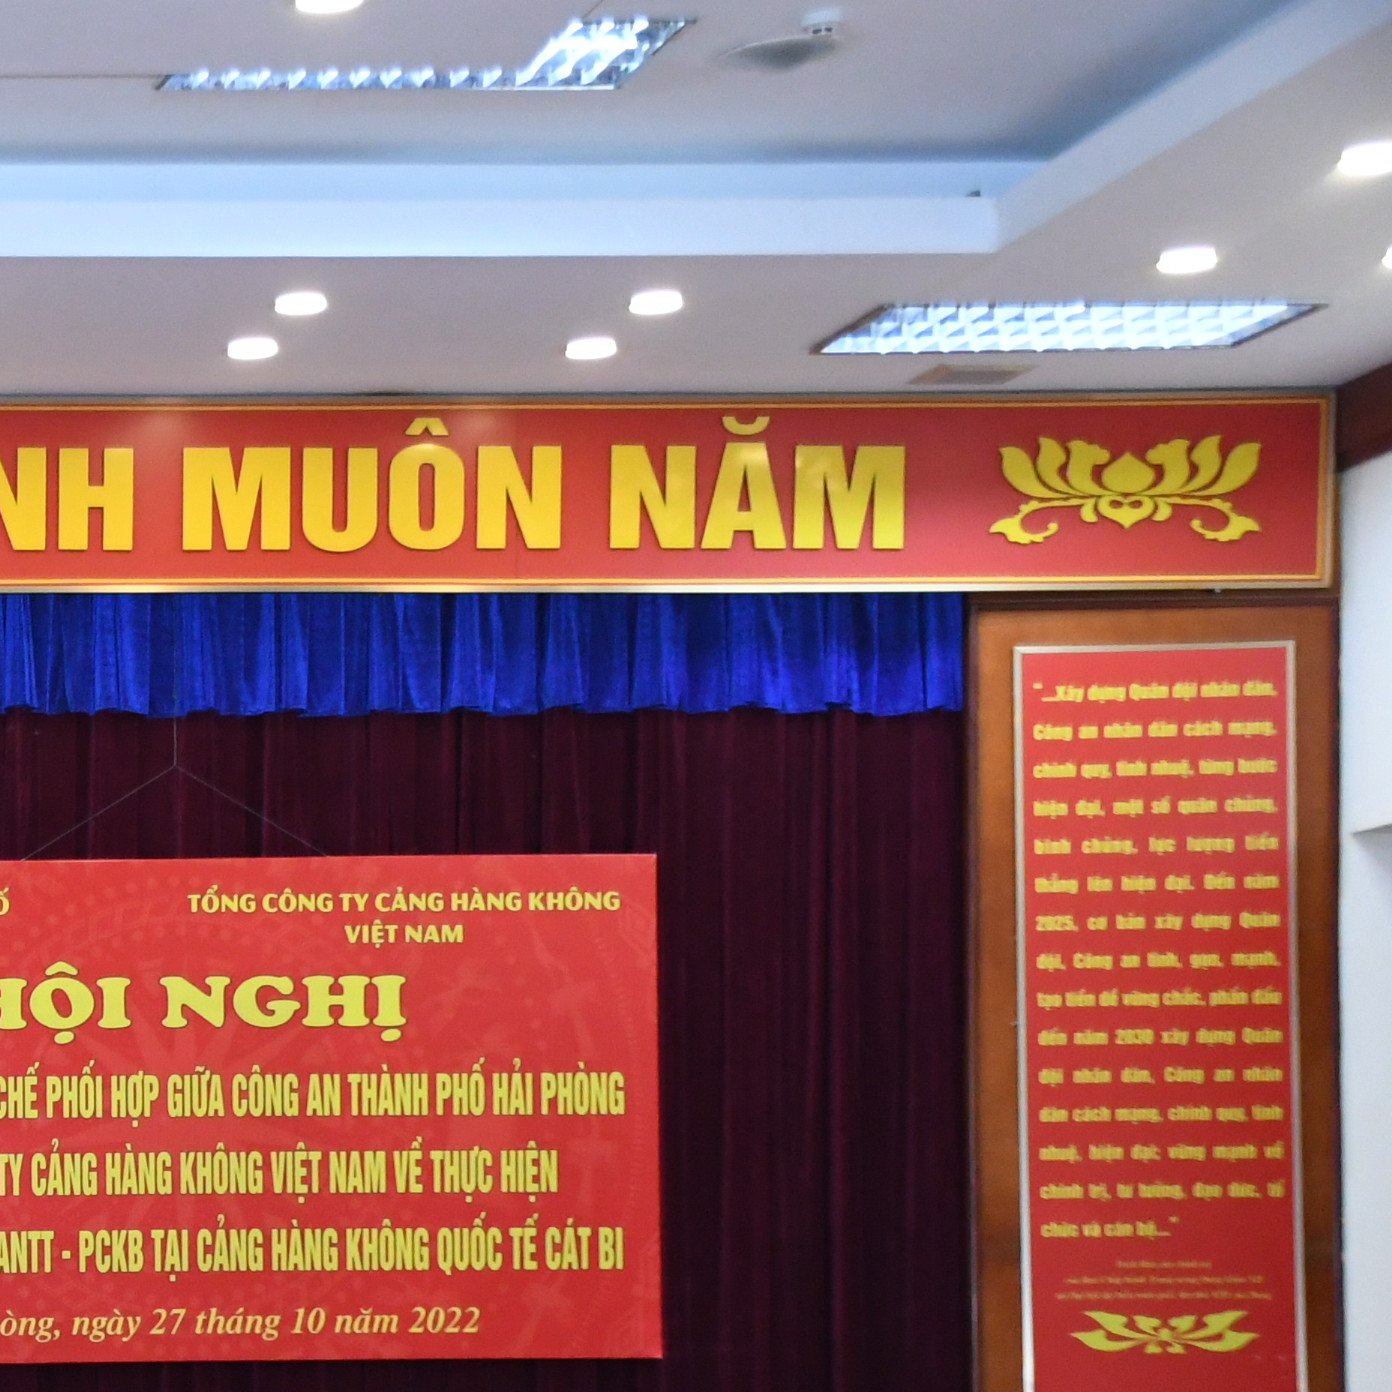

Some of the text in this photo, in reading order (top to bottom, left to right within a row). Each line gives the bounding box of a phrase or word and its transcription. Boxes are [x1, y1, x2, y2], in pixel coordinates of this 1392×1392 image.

[183, 418, 561, 552] MUÔN
[610, 417, 905, 549] NĂM
[188, 885, 620, 913] TỔNG CÔNG TY CẢNG HÀNG KHÔNG
[345, 919, 463, 948] VIỆT NAM
[160, 975, 406, 1041] NGHỊ
[47, 1060, 102, 1118] PHỐI
[111, 1071, 159, 1127] HỢP
[168, 1066, 224, 1117] GIỮA
[232, 1065, 298, 1116] CÔNG
[307, 1074, 340, 1116] AN
[348, 1064, 428, 1115] THÀNH
[436, 1057, 485, 1115] PHỐ
[493, 1058, 533, 1115] HẢI
[541, 1062, 625, 1115] PHÒNG
[32, 1138, 97, 1196] CẢNG
[106, 1143, 172, 1195] HÀNG
[180, 1142, 263, 1194] KHÔNG
[271, 1142, 321, 1203] VIỆT
[330, 1151, 386, 1193] NAM
[393, 1136, 423, 1193] VỀ
[430, 1146, 492, 1202] THỰC
[501, 1141, 557, 1202] HIỆN
[62, 1251, 70, 1259] -
[79, 1230, 143, 1273] PCKB
[151, 1229, 188, 1281] TẠI
[197, 1214, 263, 1272] CẢNG
[272, 1219, 338, 1271] HÀNG
[346, 1219, 429, 1271] KHÔNG
[437, 1212, 502, 1275] QUỐC
[509, 1213, 538, 1270] TẾ
[545, 1218, 591, 1270] CÁT
[599, 1227, 623, 1269] BI
[72, 1311, 141, 1342] ngày
[150, 1309, 186, 1334] 27
[195, 1308, 281, 1340] tháng
[292, 1308, 325, 1333] 10
[335, 1309, 398, 1333] năm
[409, 1307, 480, 1333] 2022
